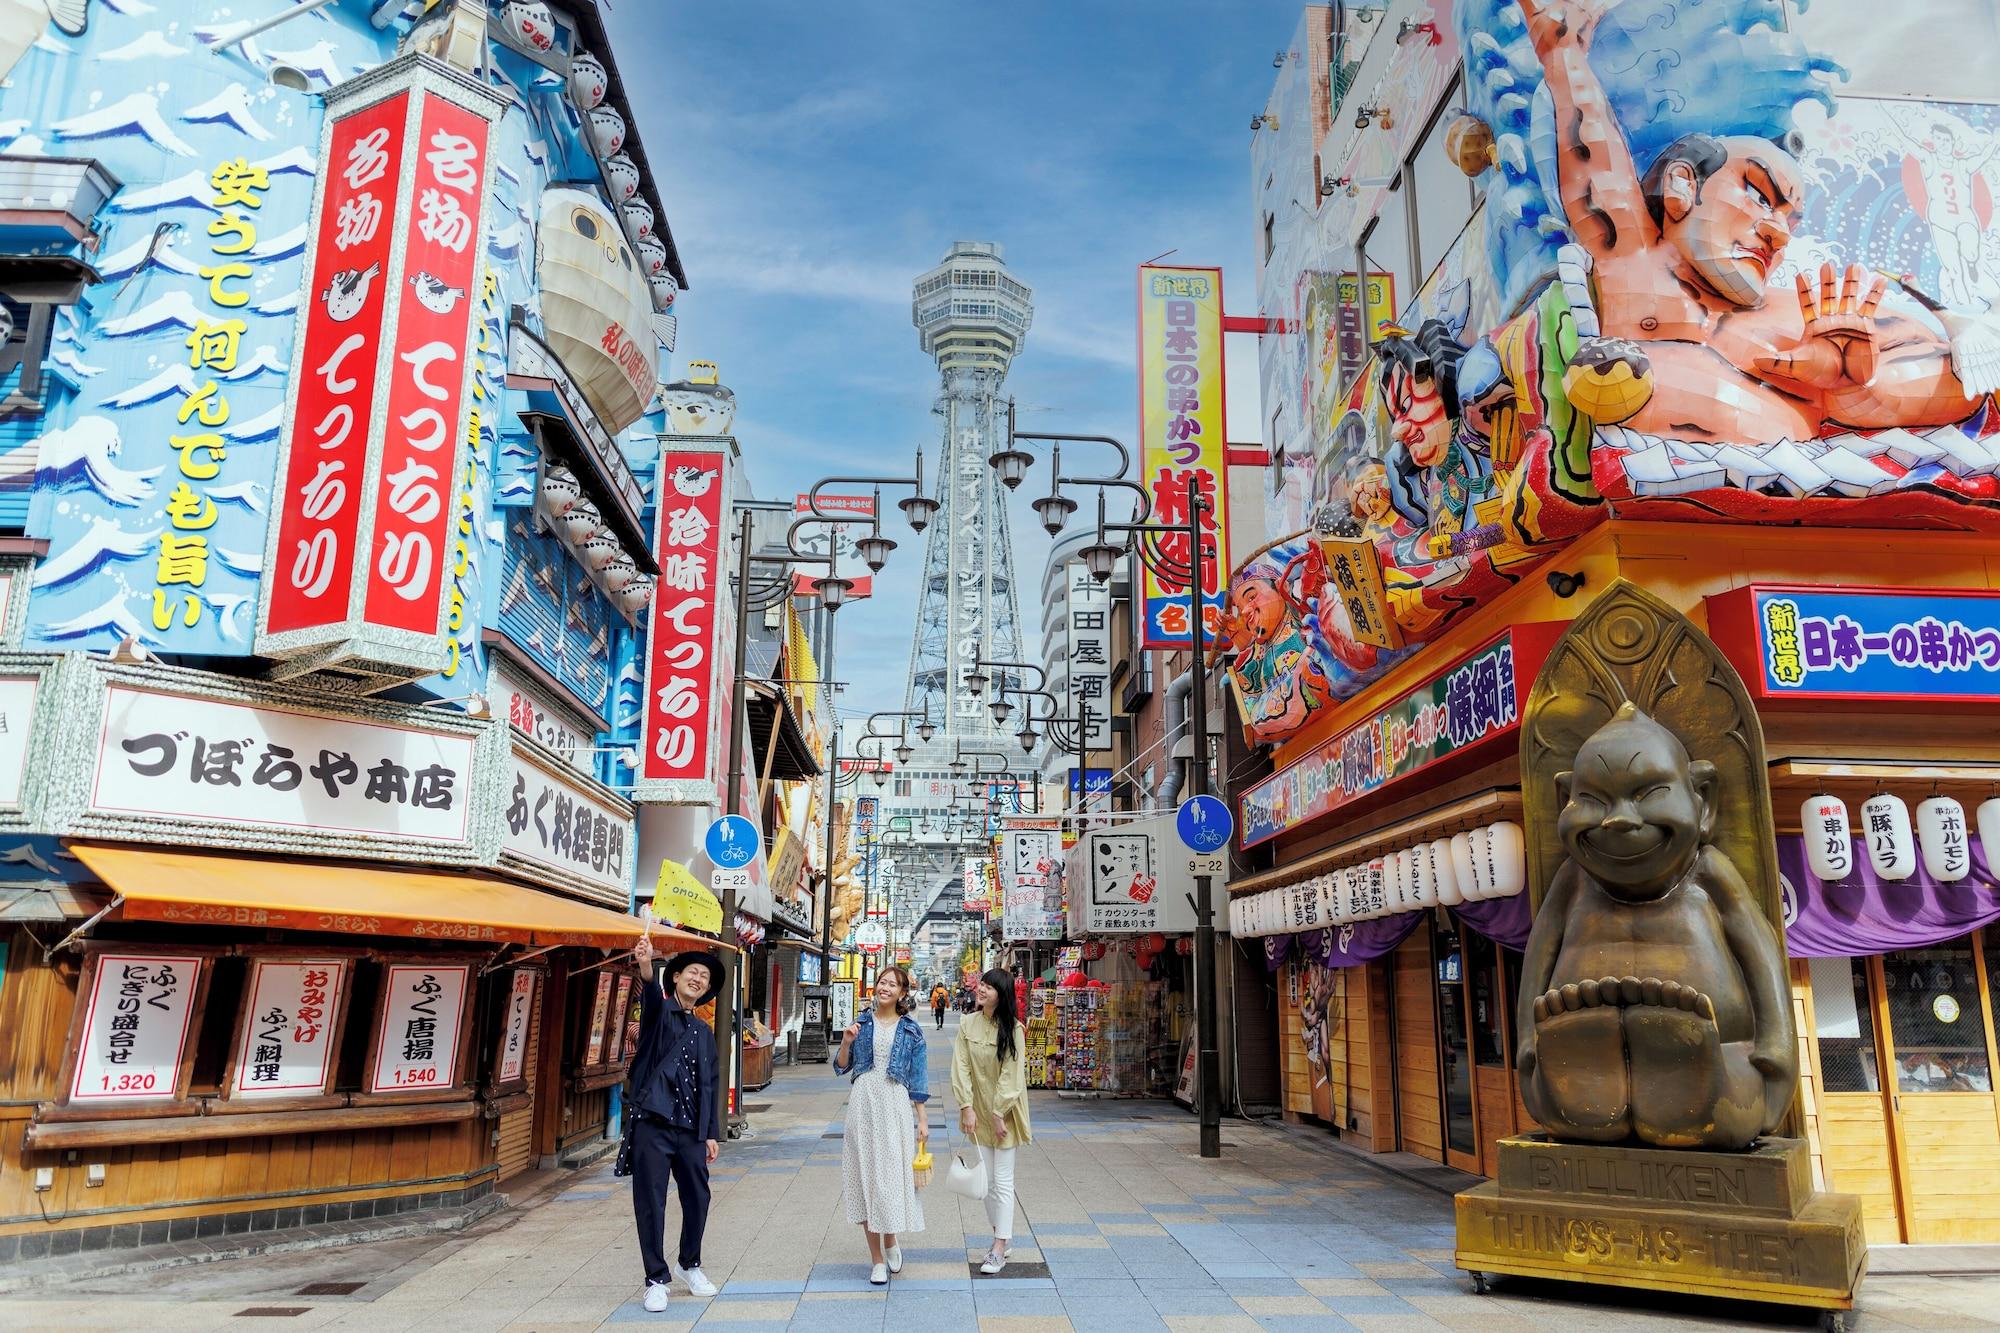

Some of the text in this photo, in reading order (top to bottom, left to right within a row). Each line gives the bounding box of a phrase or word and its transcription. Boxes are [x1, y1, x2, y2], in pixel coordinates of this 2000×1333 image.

[1153, 276, 1209, 297] 新世界
[1165, 301, 1201, 465] 日本一の串かつ
[1153, 468, 1218, 596] 横綱
[1767, 603, 1802, 682] 新世界
[1802, 619, 2000, 668] 日本一の串かつ
[1447, 652, 1499, 748] 横綱
[1392, 703, 1447, 762] 日本一の串かつ
[121, 731, 457, 811] づぼらや本店
[1818, 806, 1842, 816] 横綱
[1866, 804, 1891, 813] 串かつ
[1935, 807, 1960, 815] 串かつ
[1823, 818, 1847, 870] 串かつ
[1871, 814, 1898, 869] 豚バラ
[1941, 817, 1963, 873] ホルモン
[1293, 895, 1304, 925] ホルモン
[1348, 878, 1361, 914] サーモン
[106, 965, 149, 1064] にぎり盛合せ
[147, 965, 177, 1011] ふぐ
[294, 970, 328, 1043] おみやげ
[252, 1007, 287, 1081] ふぐ料理
[403, 975, 442, 1060] ふぐ唐揚
[102, 1074, 155, 1091] 1,320
[394, 1068, 436, 1084] 1,540
[1530, 1155, 1748, 1204] BILLIKEN
